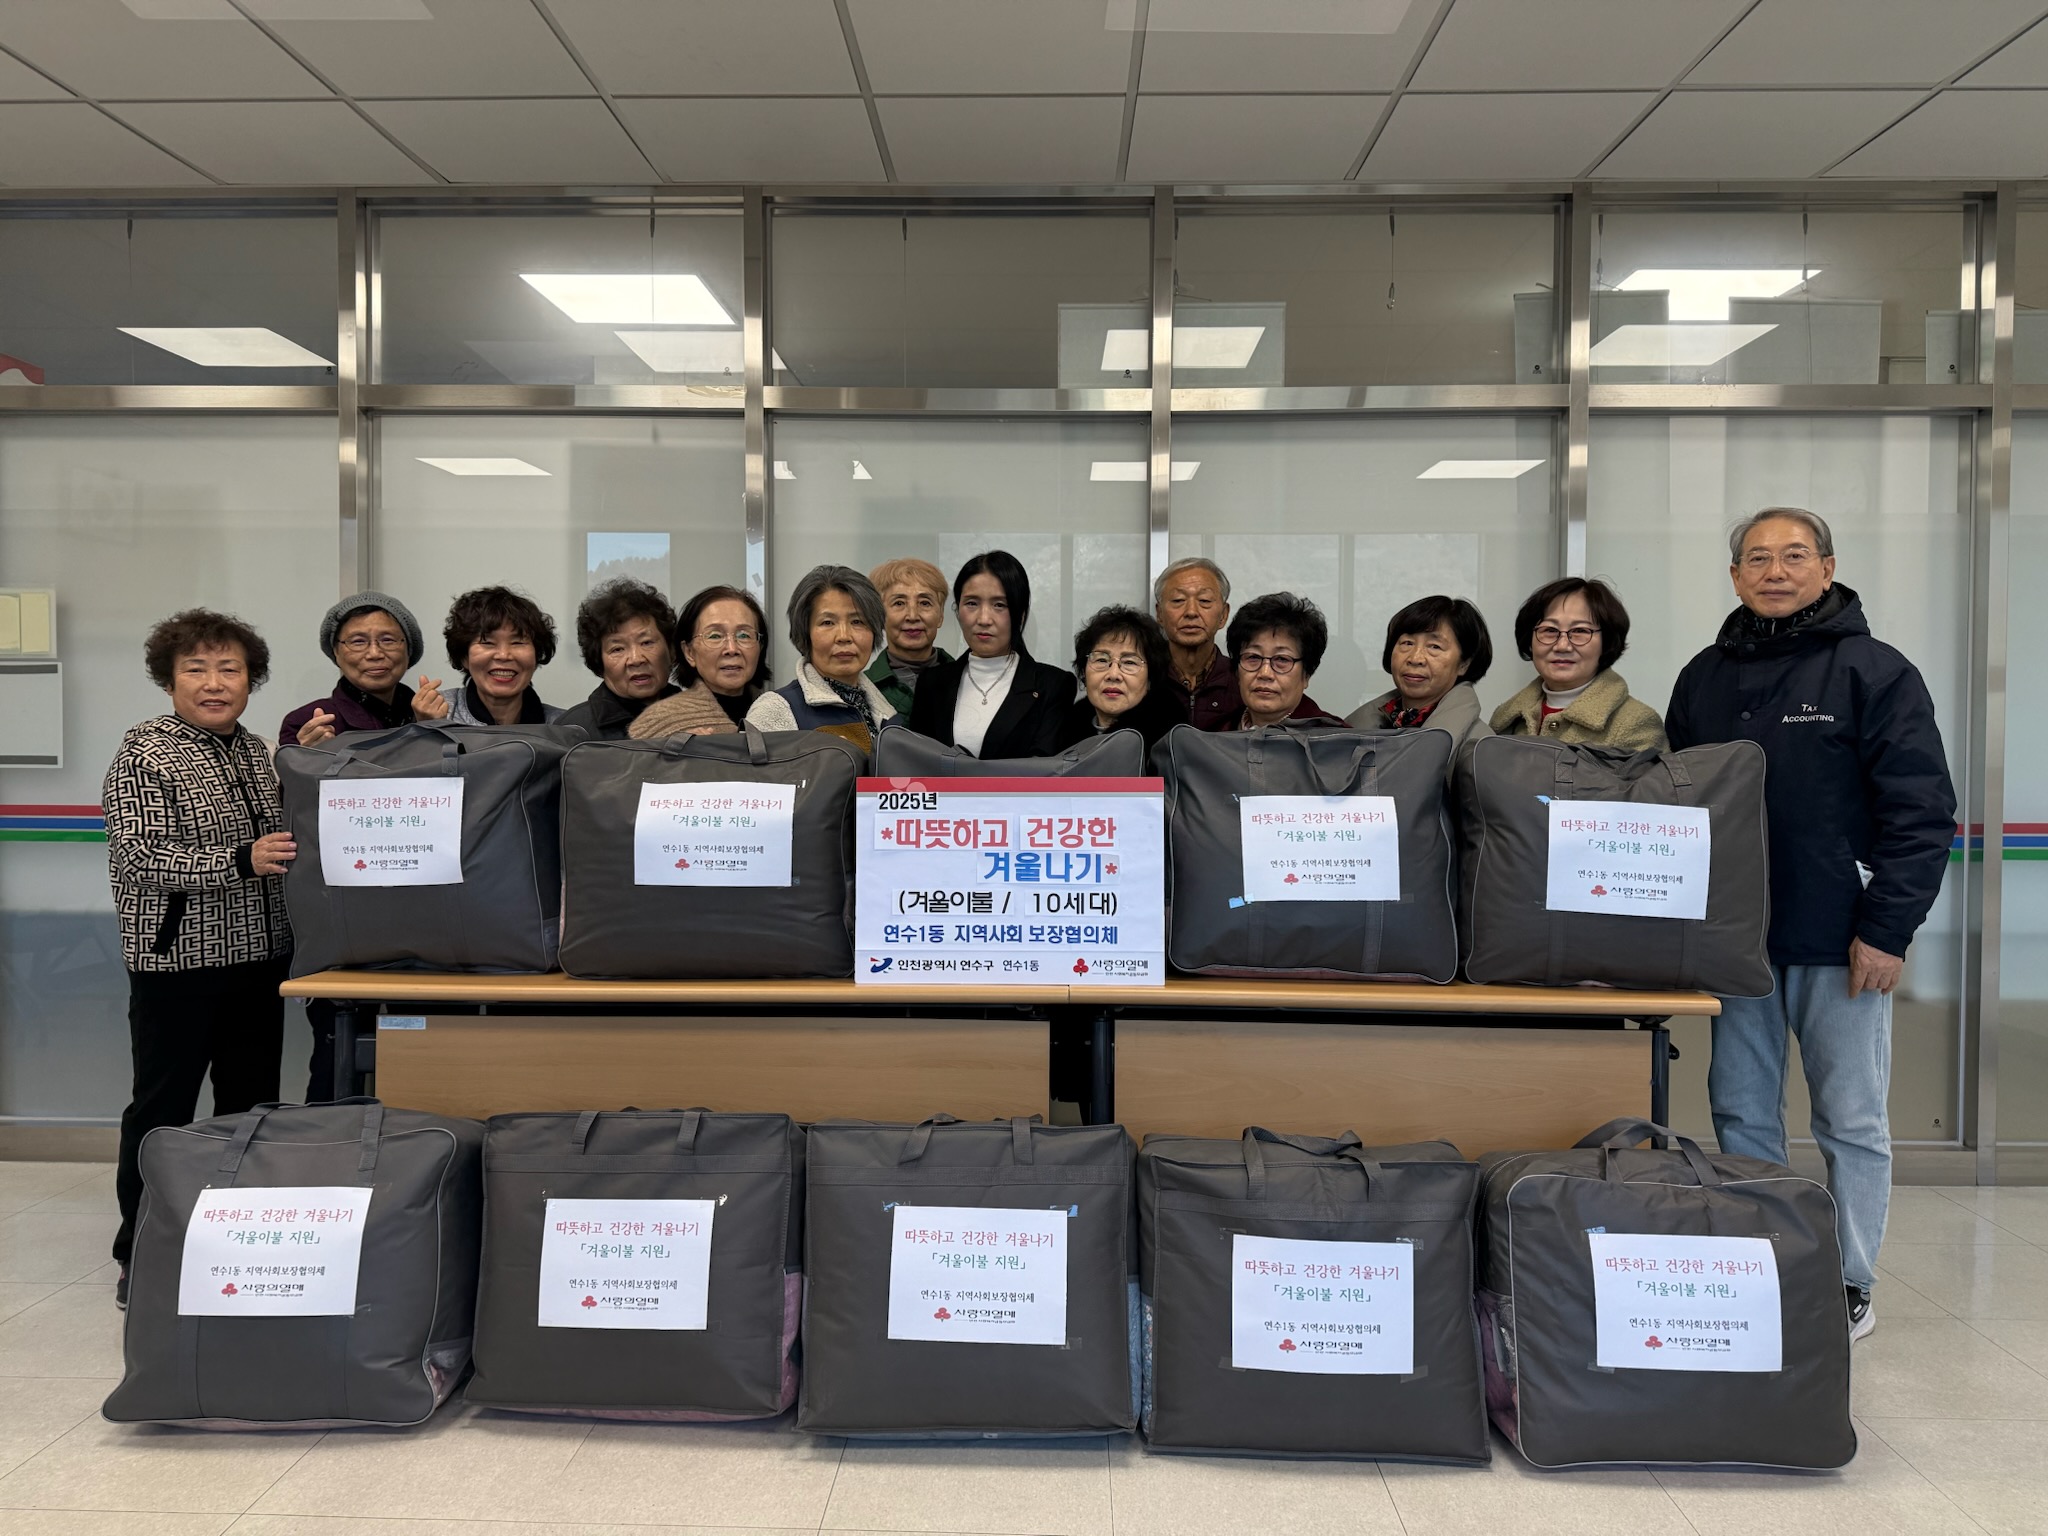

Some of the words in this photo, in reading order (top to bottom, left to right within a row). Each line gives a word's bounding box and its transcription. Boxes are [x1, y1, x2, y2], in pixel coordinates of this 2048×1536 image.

[1782, 715, 1834, 723] ACCOUNTING
[328, 798, 366, 810] 따뜻하고
[371, 797, 402, 809] 건강한
[408, 796, 451, 808] 겨울나기
[650, 799, 693, 809] 따뜻하고
[700, 799, 733, 809] 건강한
[739, 799, 782, 810] 겨울나기
[879, 793, 937, 810] 2025년
[1252, 813, 1296, 825] 따뜻하고
[1302, 813, 1335, 823] 건강한
[1341, 812, 1385, 823] 겨울나기
[1027, 818, 1116, 848] 건강한
[1562, 820, 1609, 832] 따뜻하고
[1617, 821, 1651, 835] 건강한
[1657, 825, 1699, 838] 겨울나기
[343, 846, 366, 854] 연수1동
[370, 845, 433, 853] 지역사회보장협의체
[662, 845, 690, 853] 연수1동
[694, 845, 764, 854] 지역사회보장협의체
[369, 859, 419, 867] 사랑의열매
[1270, 860, 1297, 868] 연수1동
[1302, 859, 1371, 868] 지역사회보장협의체
[1578, 870, 1608, 878] 연수1동
[1612, 872, 1683, 884] 지역사회보장협의체
[1610, 887, 1668, 896] 사랑의열매
[899, 891, 993, 914] (겨울이불
[1033, 892, 1118, 916] 10세대)
[884, 925, 944, 943] 연수1동
[954, 925, 1022, 943] 지역사회
[1029, 925, 1118, 944] 보장협의체
[898, 959, 956, 971] 인천광역시
[960, 960, 994, 971] 연수구
[1003, 960, 1039, 972] 연수1동
[1091, 959, 1149, 971] 사랑의열매
[204, 1209, 253, 1222] 따뜻하고
[260, 1209, 298, 1222] 건강한
[304, 1209, 353, 1222] 겨울나기
[556, 1222, 603, 1236] 따뜻하고
[610, 1222, 645, 1236] 건강한
[651, 1222, 699, 1236] 겨울나기
[905, 1229, 954, 1244] 따뜻하고
[962, 1230, 998, 1246] 건강한
[1005, 1232, 1054, 1247] 겨울나기
[211, 1266, 241, 1276] 연수1동
[245, 1266, 325, 1276] 지역사회보장협의체
[1245, 1260, 1296, 1275] 따뜻하고
[1304, 1264, 1342, 1279] 건강한
[1349, 1265, 1399, 1280] 겨울나기
[1606, 1257, 1659, 1272] 따뜻하고
[1666, 1259, 1704, 1274] 건강한
[1712, 1260, 1763, 1275] 겨울나기
[241, 1284, 305, 1293] 사랑의열매
[569, 1279, 598, 1288] 연수1동
[602, 1279, 678, 1290] 지역사회보장협의체
[600, 1297, 659, 1306] 사랑의열매
[921, 1290, 951, 1300] 연수1동
[956, 1291, 1034, 1303] 지역사회보장협의체
[955, 1309, 1016, 1318] 사랑의열매
[1264, 1321, 1296, 1331] 연수1동
[1301, 1322, 1381, 1334] 지역사회보장협의체
[1630, 1318, 1662, 1328] 연수1동
[1667, 1318, 1749, 1330] 지역사회보장협의체
[1300, 1341, 1362, 1350] 사랑의열매
[1666, 1337, 1731, 1347] 사랑의열매
